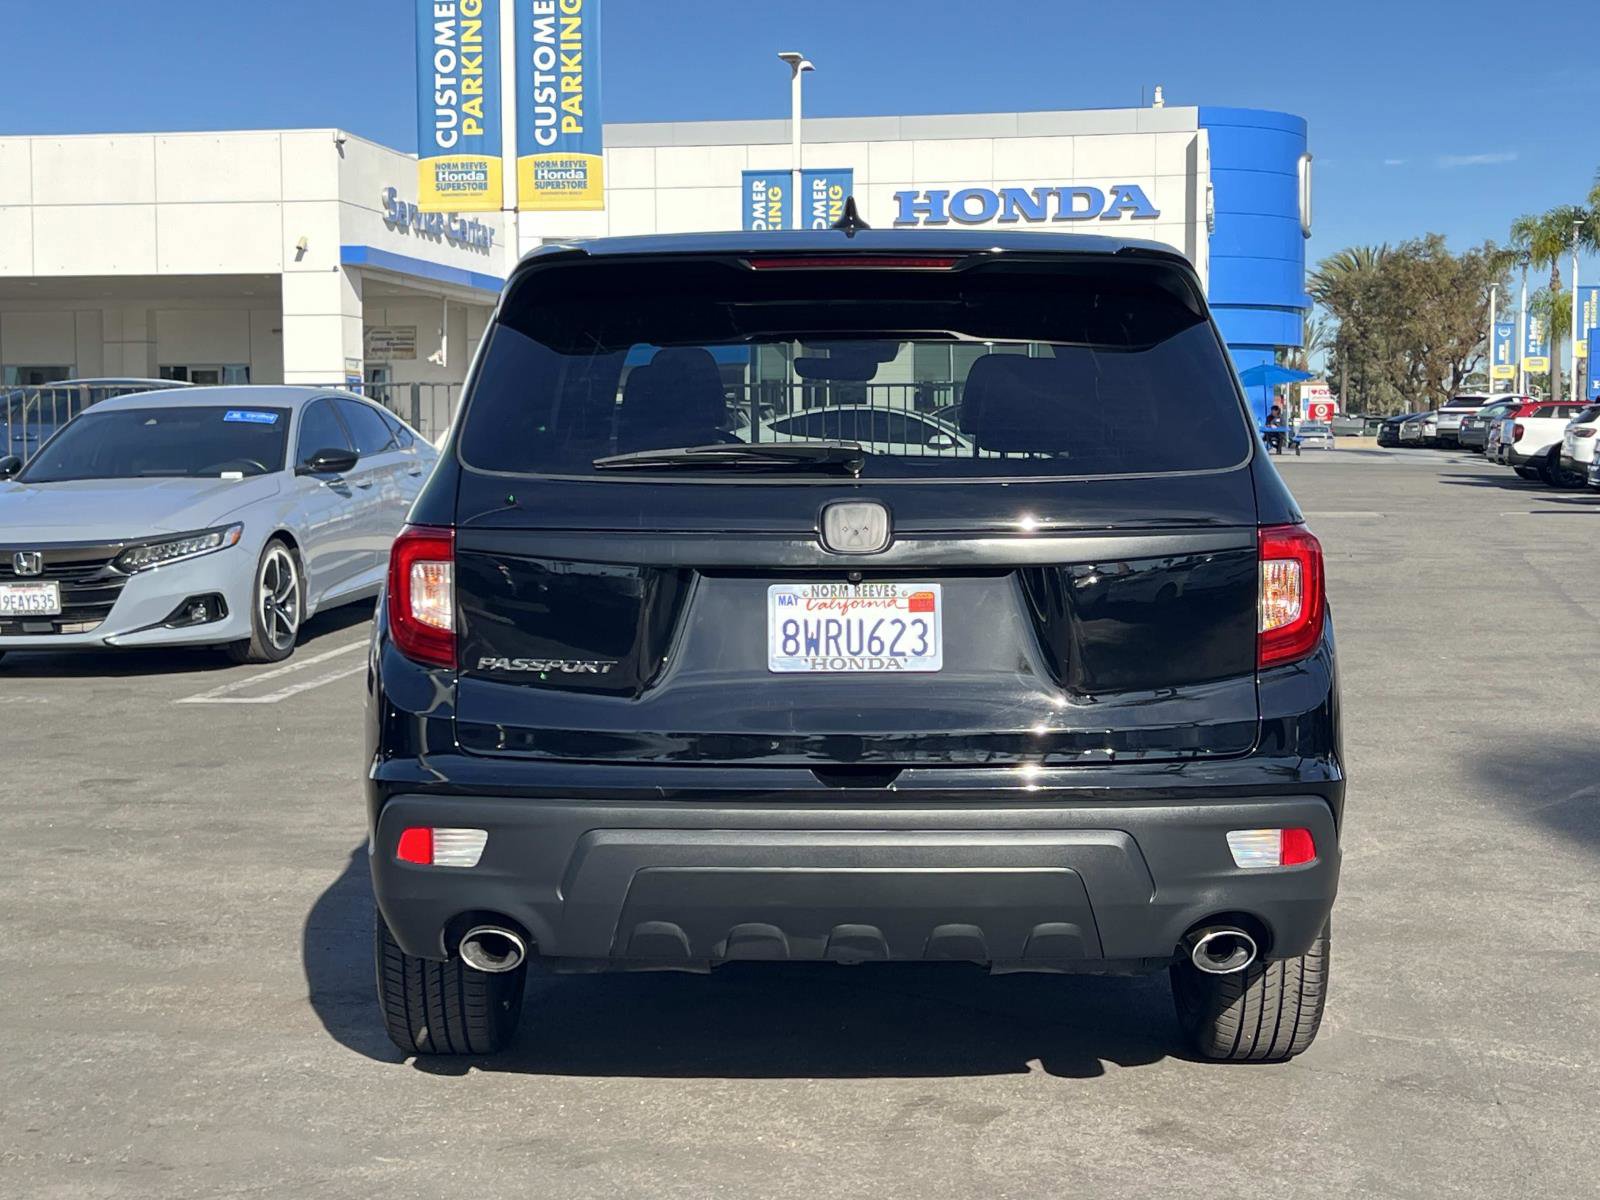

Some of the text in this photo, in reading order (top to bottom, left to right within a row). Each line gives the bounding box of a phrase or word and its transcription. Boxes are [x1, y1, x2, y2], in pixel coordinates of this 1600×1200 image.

[460, 0, 483, 135] PARKING
[435, 161, 487, 170] NORM REEVES
[534, 160, 587, 168] NORM REEVES
[438, 171, 485, 182] Honda
[537, 170, 584, 180] Honda
[435, 182, 488, 191] SUPERSTORE
[534, 181, 587, 190] SUPERSTORE
[893, 184, 1160, 226] HONDA
[382, 187, 495, 248] Service Center
[811, 585, 897, 597] NORM REEVES
[2, 594, 55, 610] 9EAY535
[806, 597, 908, 616] California
[782, 618, 928, 657] 8WRU623
[477, 657, 618, 673] PASSPORT
[810, 657, 903, 670] HONDA
